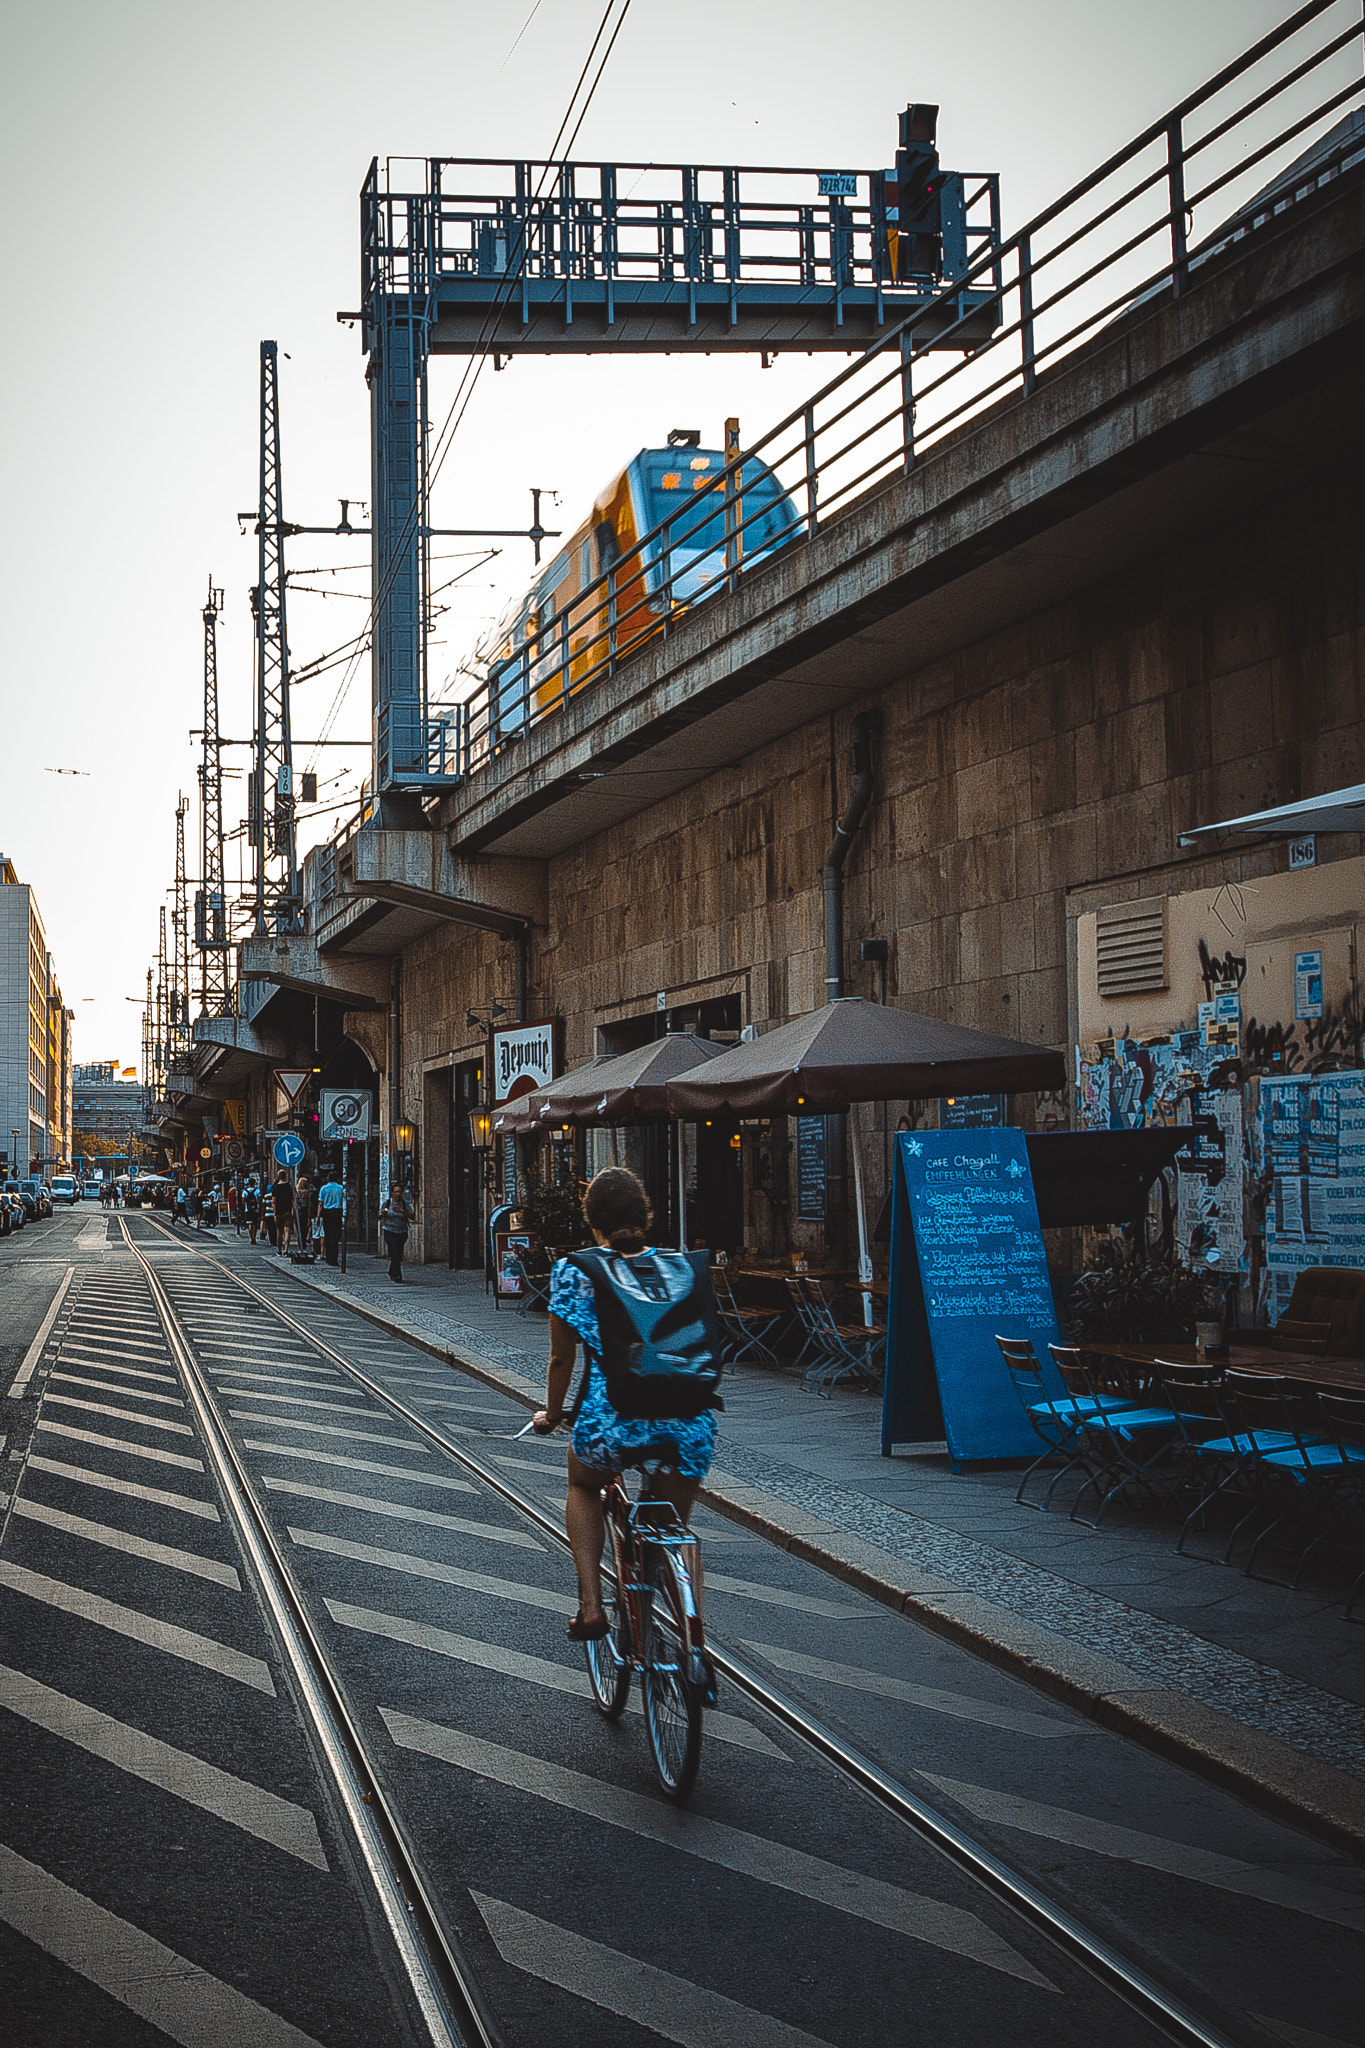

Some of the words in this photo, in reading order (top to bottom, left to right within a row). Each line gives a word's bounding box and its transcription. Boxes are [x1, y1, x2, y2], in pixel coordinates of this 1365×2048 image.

[283, 780, 289, 791] 6
[1291, 842, 1314, 864] 186
[500, 1032, 549, 1090] Deponie
[338, 1103, 356, 1118] 30
[335, 1127, 359, 1137] ONE
[1272, 1120, 1300, 1135] CRISIS
[1310, 1120, 1338, 1136] CRISIS
[926, 1158, 949, 1169] CAFE
[953, 1153, 1001, 1170] Chagall
[925, 1168, 998, 1181] EMPFEHLUNGEN
